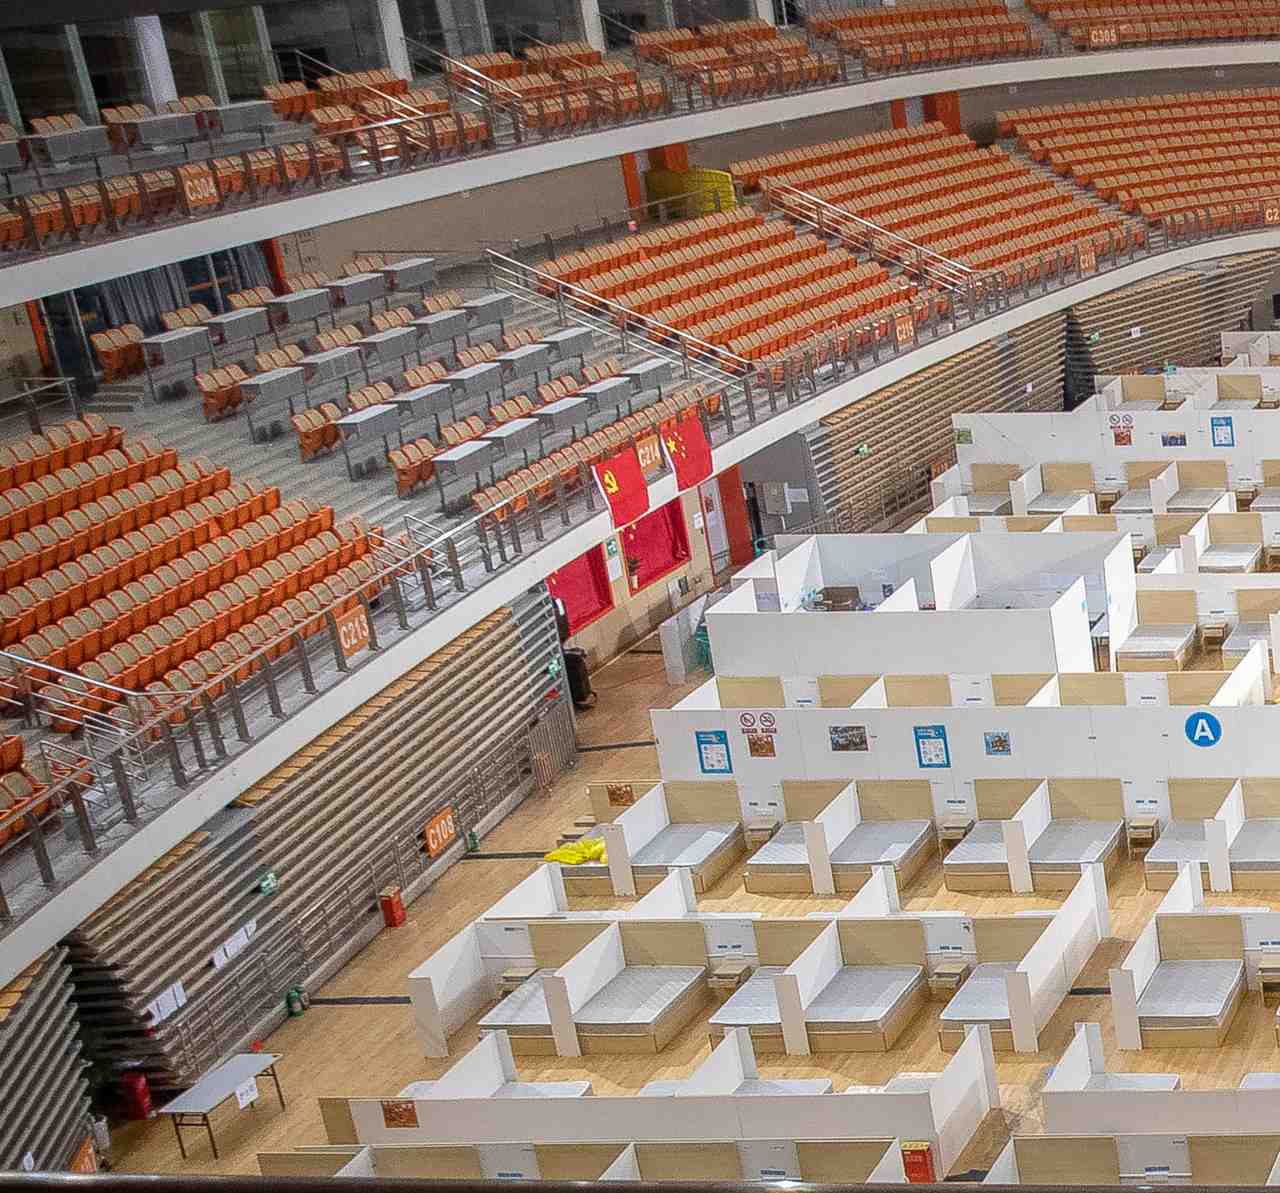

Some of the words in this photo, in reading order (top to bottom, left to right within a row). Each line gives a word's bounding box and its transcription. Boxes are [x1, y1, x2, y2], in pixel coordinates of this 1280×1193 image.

[340, 614, 369, 649] C213
[1193, 718, 1216, 742] A
[426, 814, 455, 850] C108
